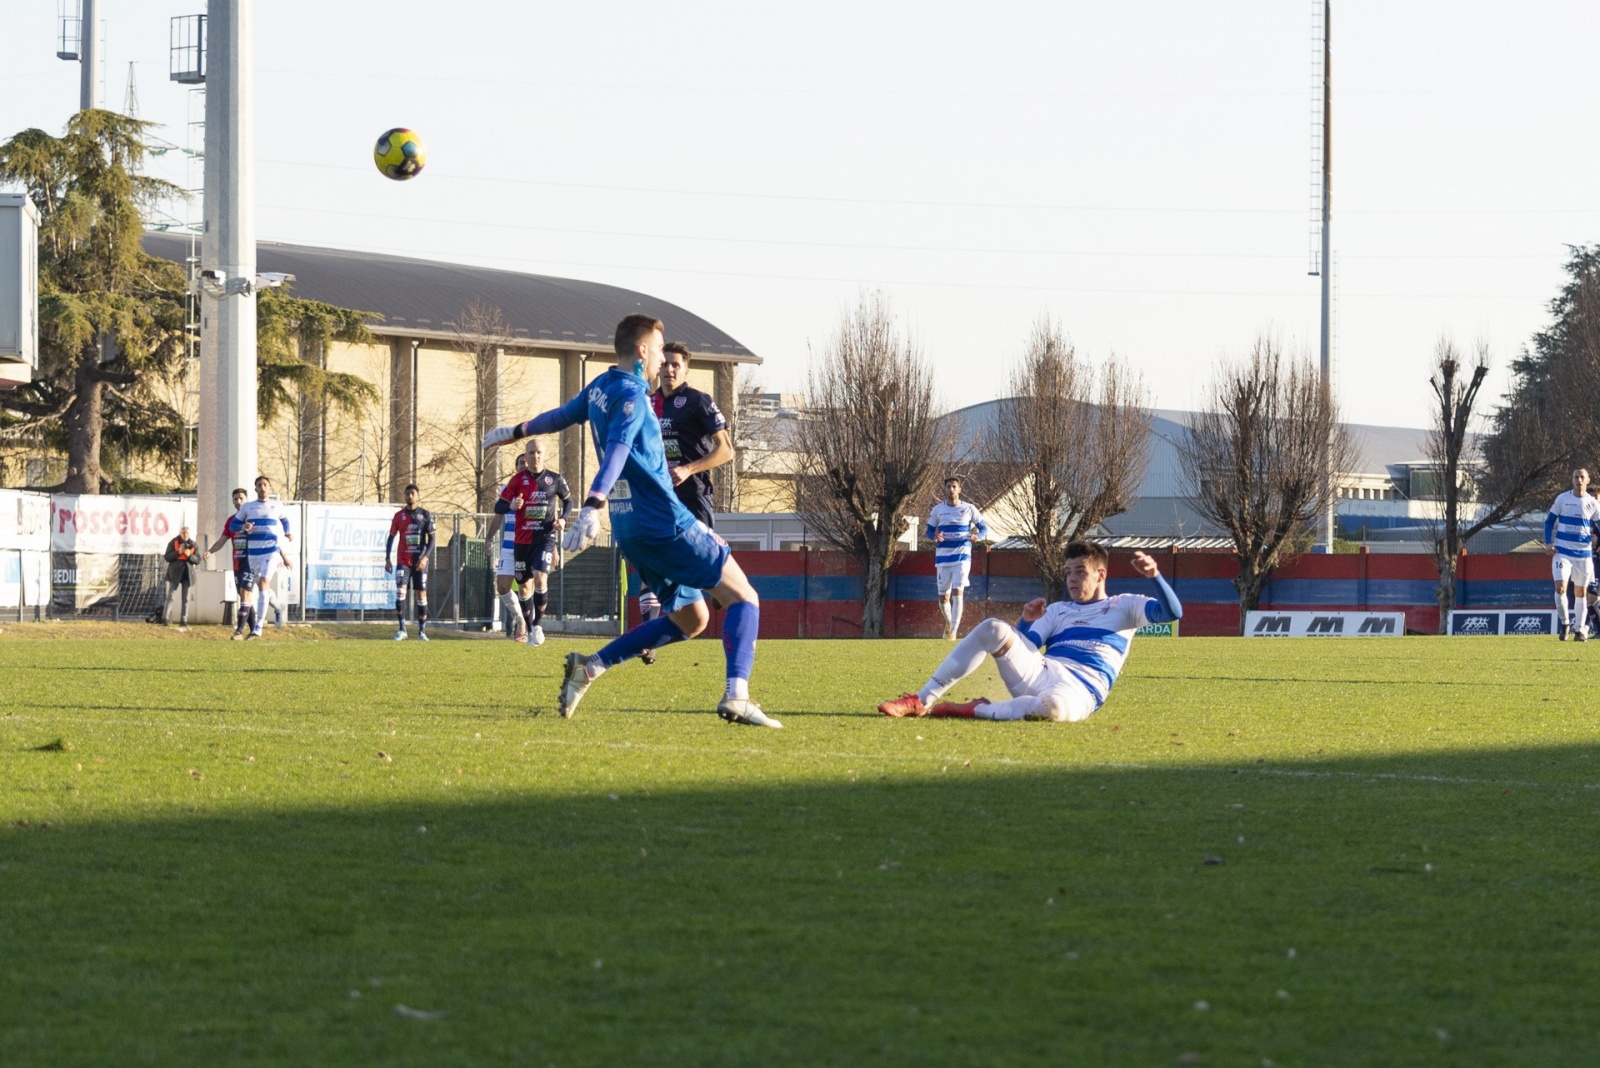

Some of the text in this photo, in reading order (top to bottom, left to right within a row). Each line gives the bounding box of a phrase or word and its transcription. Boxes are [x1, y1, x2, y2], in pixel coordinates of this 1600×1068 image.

[58, 506, 170, 536] rossetto
[243, 571, 254, 582] 23
[351, 593, 361, 604] DI
[1136, 624, 1171, 634] ARDA
